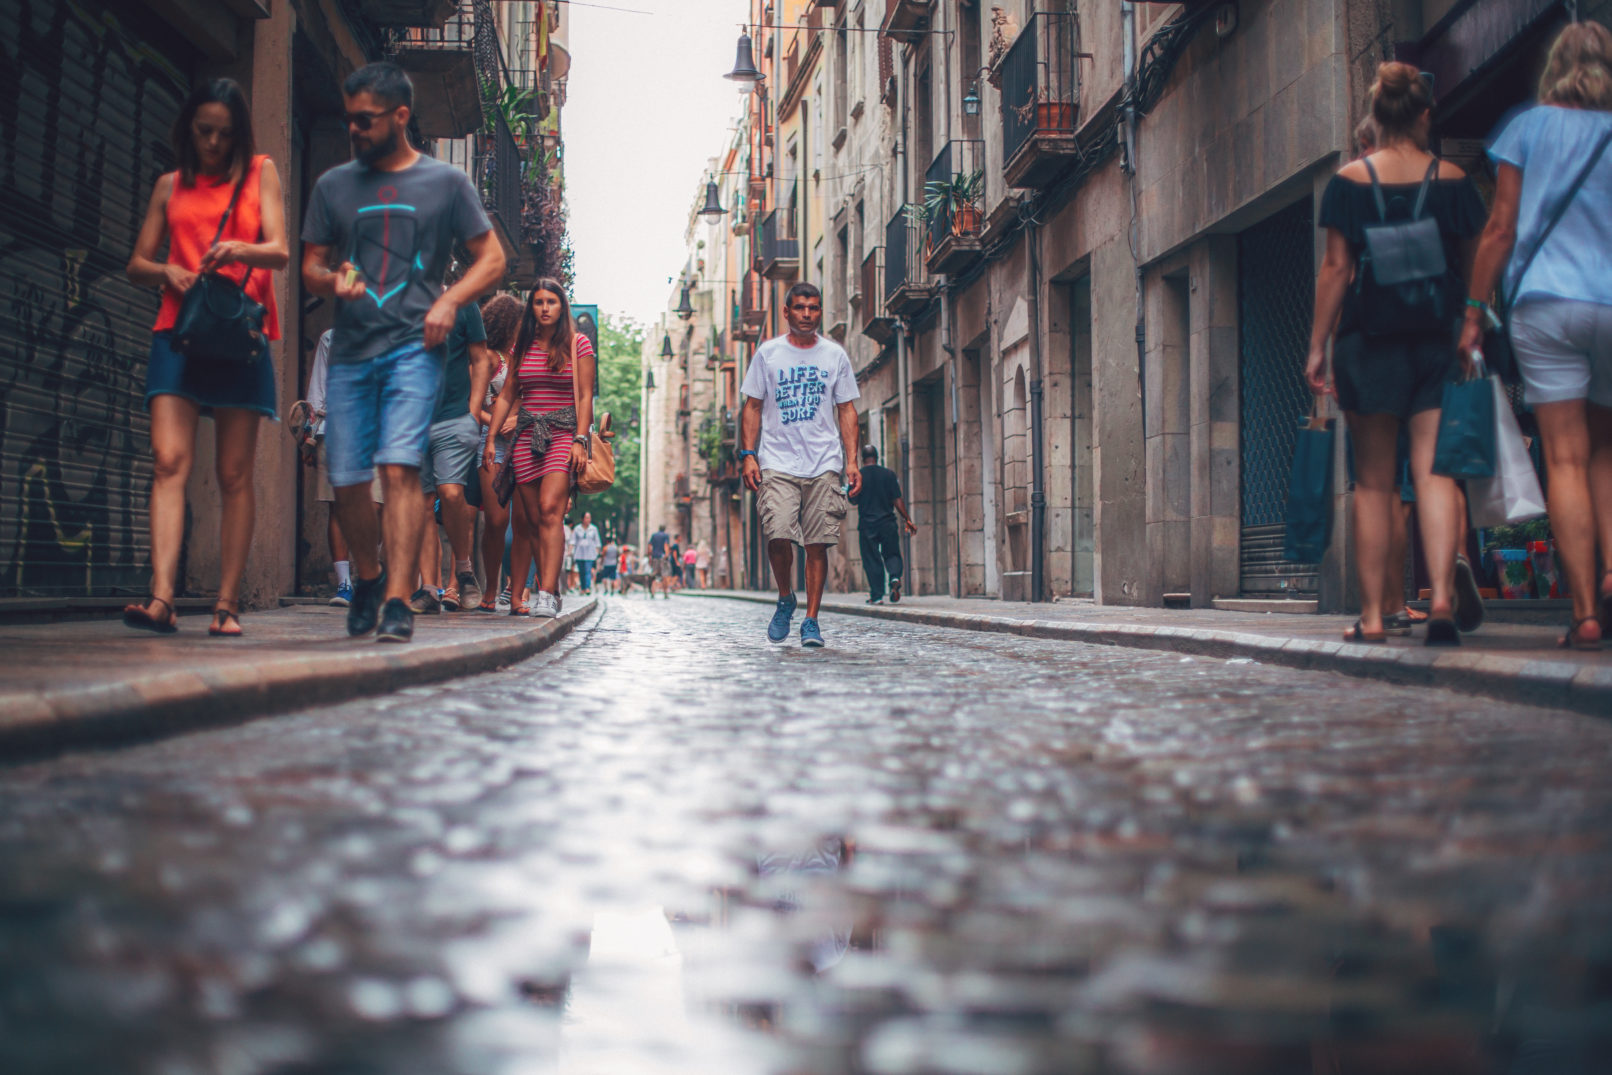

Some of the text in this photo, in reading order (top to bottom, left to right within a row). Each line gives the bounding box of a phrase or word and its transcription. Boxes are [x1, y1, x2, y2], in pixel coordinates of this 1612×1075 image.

[777, 365, 819, 386] LIFE
[775, 381, 826, 402] BETTER
[778, 395, 820, 409] WHEN YOU
[781, 406, 817, 425] SURF
